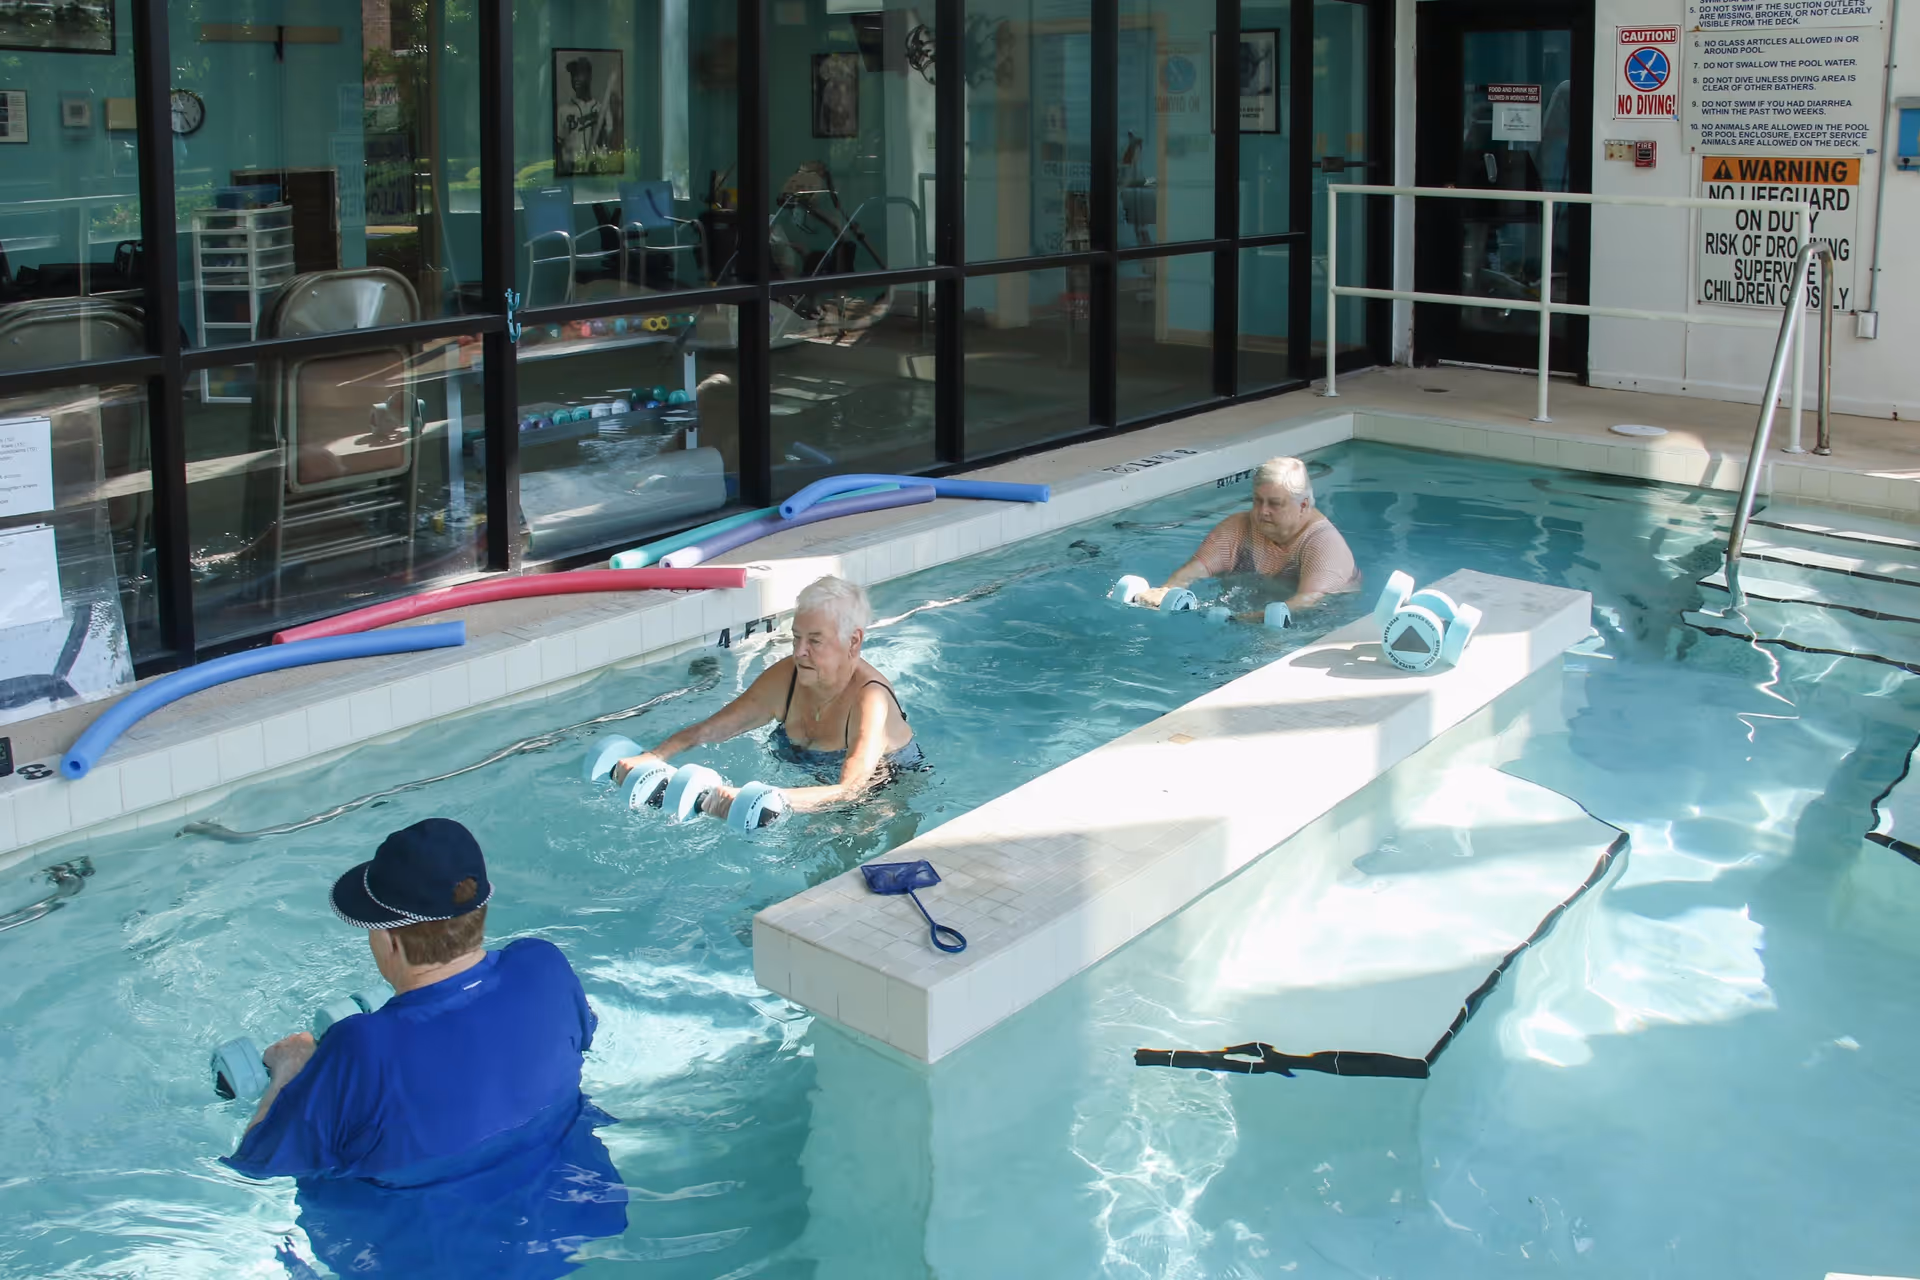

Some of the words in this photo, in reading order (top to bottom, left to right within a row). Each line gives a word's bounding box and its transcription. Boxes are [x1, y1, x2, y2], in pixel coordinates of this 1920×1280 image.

[1699, 5, 1712, 13] DO
[1783, 1, 1822, 9] SUCTION
[1823, 0, 1865, 8] OUTLETS
[1717, 11, 1753, 20] MISSING,
[1755, 10, 1794, 18] BROKEN,
[1810, 8, 1829, 16] NOT
[1830, 7, 1872, 15] CLEARLY
[1756, 18, 1773, 26] THE
[1622, 31, 1675, 42] CAUTION!
[1717, 39, 1745, 47] GLASS
[1746, 38, 1787, 46] ARTICLES
[1779, 60, 1797, 68] THE
[1824, 59, 1857, 67] WATER.
[1790, 75, 1820, 83] DIVING
[1618, 94, 1632, 114] NO
[1636, 94, 1676, 114] DIVING!
[1738, 160, 1848, 182] WARNING
[1709, 185, 1734, 200] NO
[1736, 209, 1762, 231] ON
[1768, 210, 1819, 233] DUY
[1706, 233, 1738, 255] RISK
[1742, 234, 1762, 256] OF
[1704, 279, 1775, 305] CHILDREN
[717, 628, 731, 648] 4
